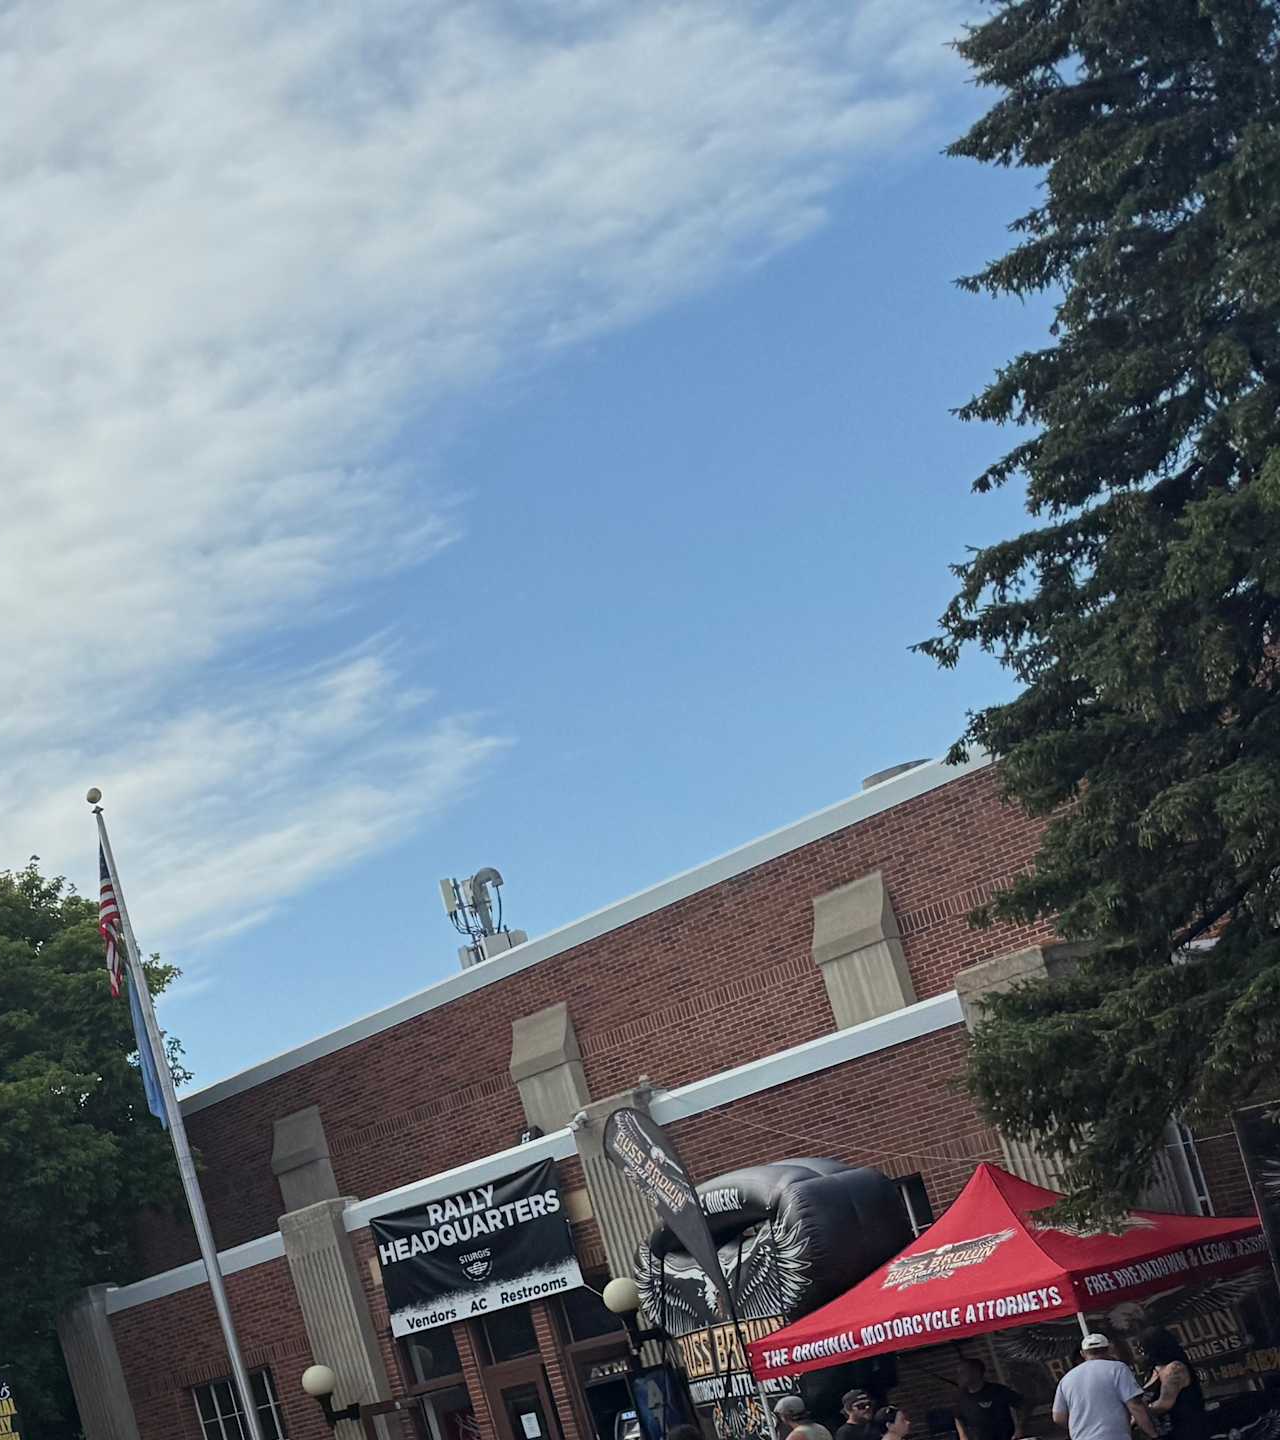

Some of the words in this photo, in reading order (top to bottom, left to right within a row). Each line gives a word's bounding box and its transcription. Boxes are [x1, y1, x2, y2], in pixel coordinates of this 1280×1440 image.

[615, 1132, 645, 1164] RUSS
[644, 1162, 688, 1209] BROWN
[426, 1184, 495, 1226] RALLY
[378, 1189, 561, 1266] HEADQUARTERS
[458, 1247, 491, 1265] STURGIS
[928, 1246, 997, 1268] BROWN
[1084, 1276, 1114, 1296] FREE
[1117, 1252, 1190, 1293] BREAKDOWN
[406, 1306, 458, 1331] Vendors
[470, 1297, 488, 1314] AC
[500, 1274, 569, 1305] Restrooms
[762, 1347, 790, 1369] THE
[792, 1331, 860, 1363] ORIGINAL
[860, 1308, 962, 1347] MOTORCYCLE
[965, 1285, 1063, 1325] ATTORNEYS
[590, 1359, 629, 1379] ATM
